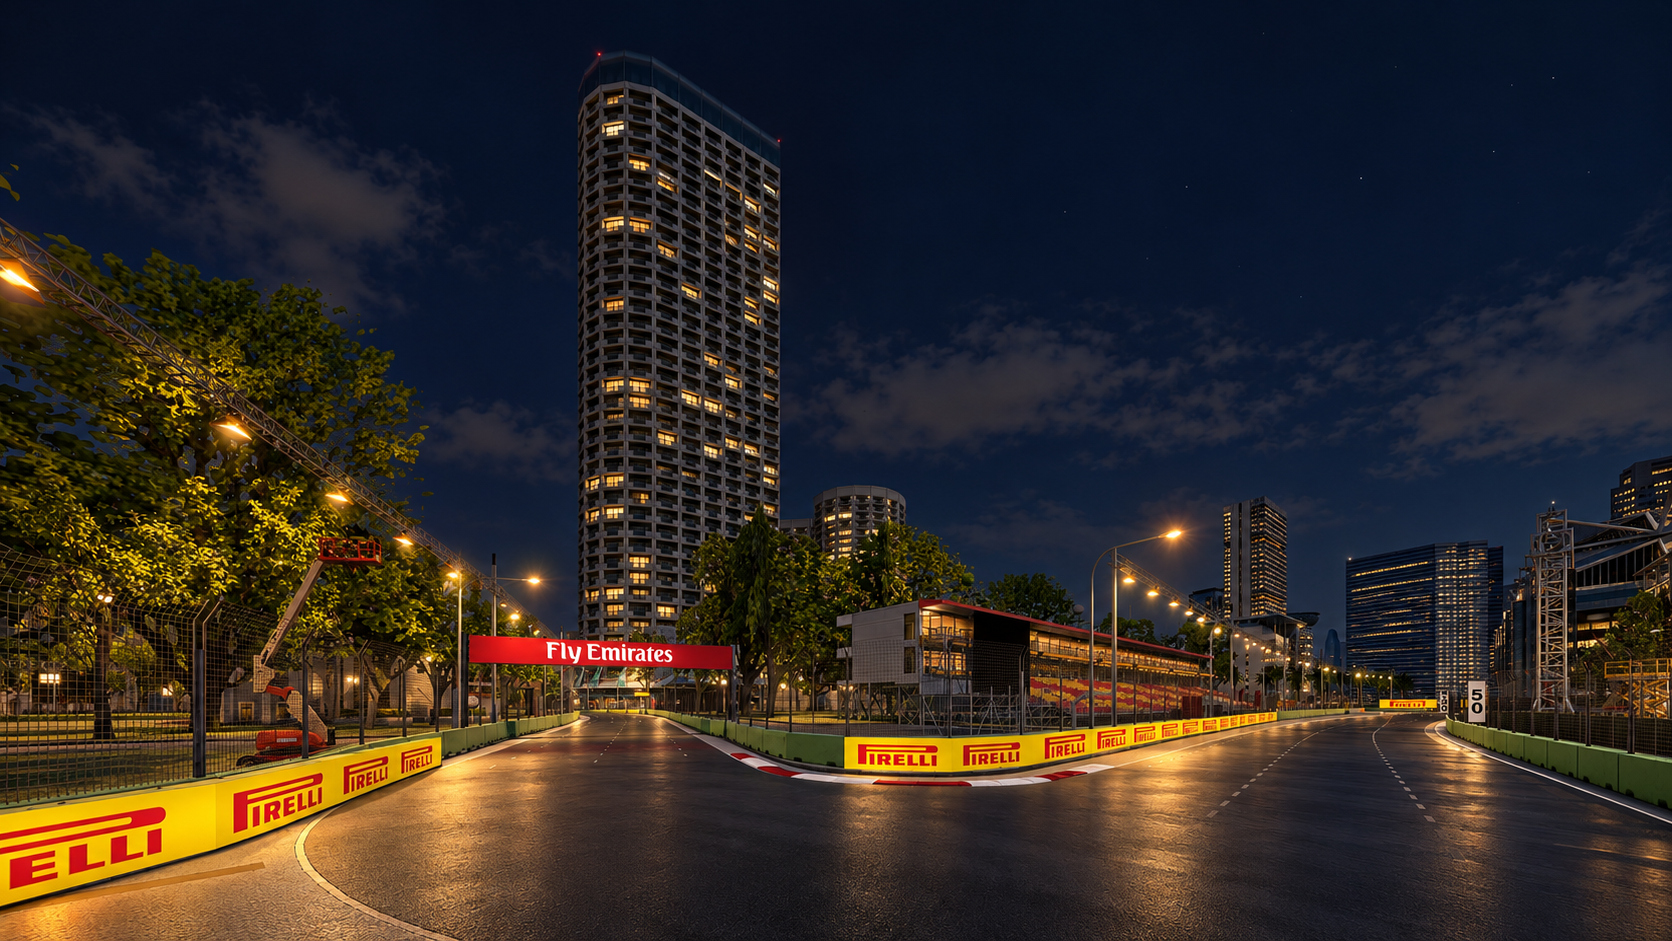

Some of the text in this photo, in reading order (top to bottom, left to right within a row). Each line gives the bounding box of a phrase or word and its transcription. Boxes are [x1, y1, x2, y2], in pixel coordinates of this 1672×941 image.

[546, 641, 673, 664] Fly Emirates
[1472, 689, 1483, 714] 50
[1045, 734, 1086, 760] PIRELLI
[1097, 729, 1126, 750] PIRELLI
[401, 745, 433, 774] PIRELLI
[858, 744, 938, 767] PIRELLI
[963, 742, 1021, 767] PIRELLI
[343, 755, 389, 795] PIRELLI
[233, 772, 323, 834] PIRELLI
[0, 806, 166, 890] ELLI
